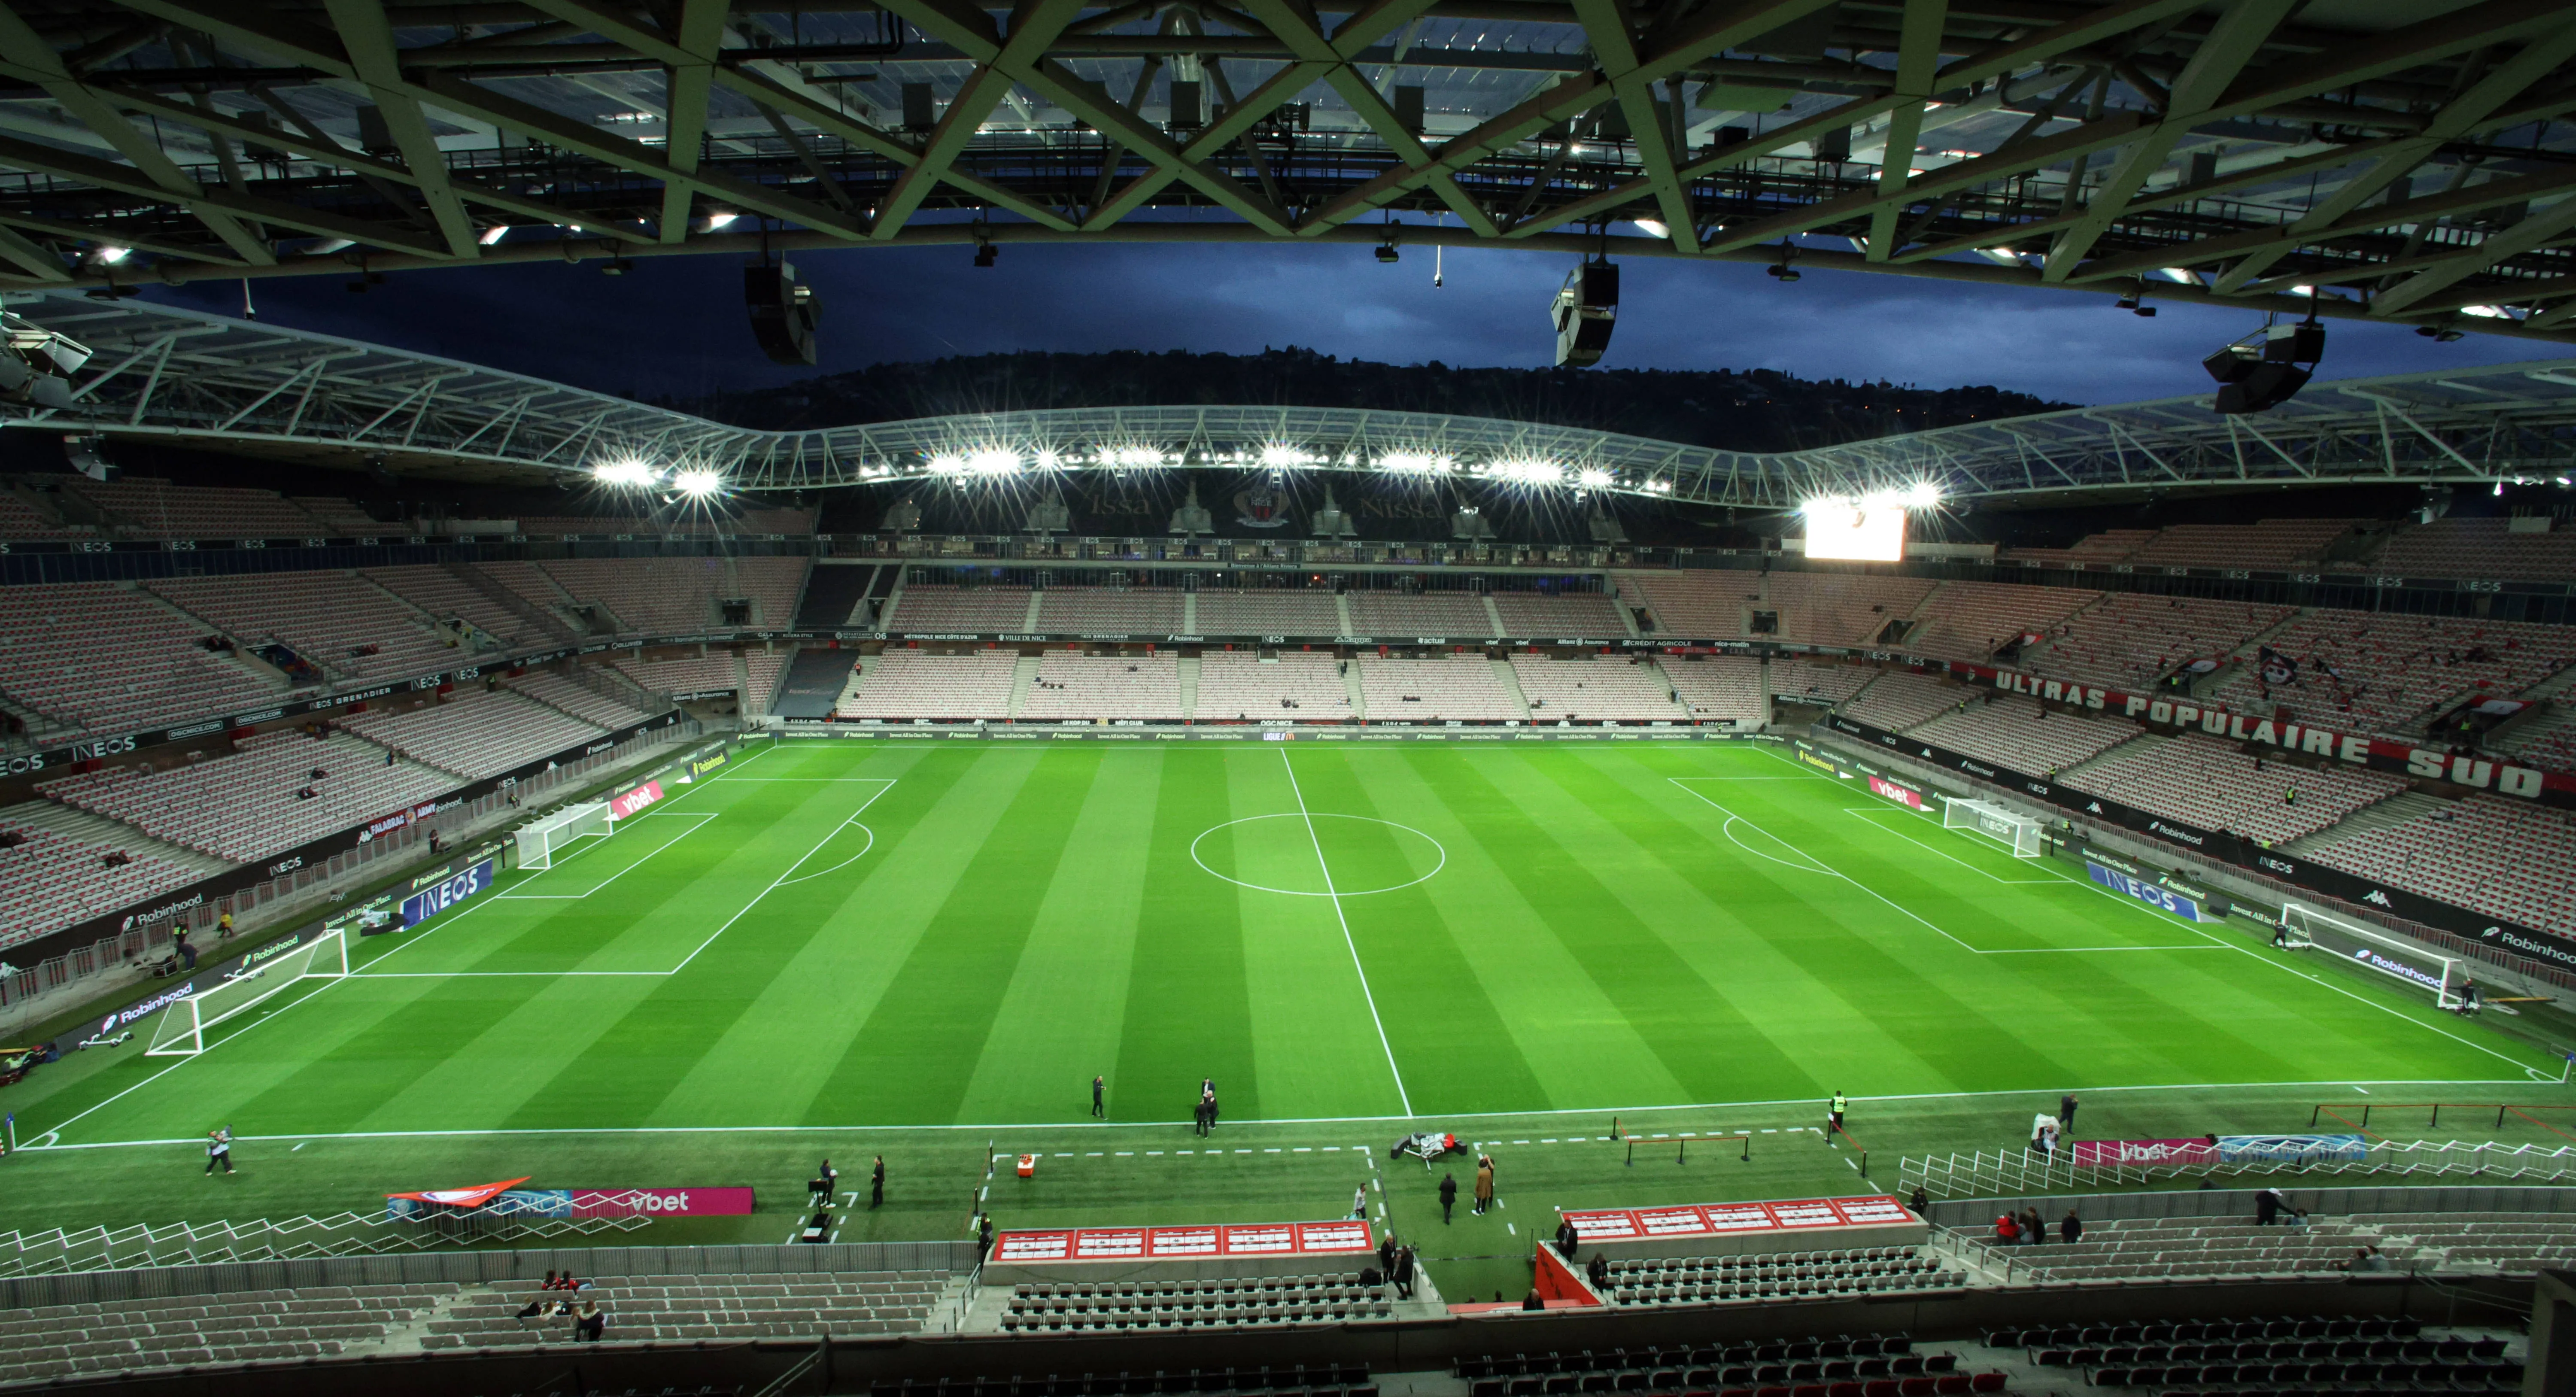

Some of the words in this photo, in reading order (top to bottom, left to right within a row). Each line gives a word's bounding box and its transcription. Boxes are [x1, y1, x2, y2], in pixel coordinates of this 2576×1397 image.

[70, 543, 112, 552] INEOS
[161, 541, 195, 550] INEOS
[2365, 577, 2403, 586] INEOS
[2457, 581, 2502, 592] INEOS
[1864, 651, 1890, 661] INEOS
[1901, 655, 1925, 667] INEOS
[411, 675, 441, 690] INEOS
[452, 668, 479, 681] INEOS
[309, 698, 332, 710] INEOS
[336, 687, 392, 705] GRENADIER
[238, 710, 282, 725] OGCNICE.COM
[170, 722, 222, 738] OGCNICE.COM
[1263, 732, 1281, 741] LIGUE
[1996, 671, 2105, 710] ULTRAS
[2125, 695, 2371, 764] POPULAIRE
[2406, 748, 2544, 799] SUD
[72, 735, 136, 762] INEOS
[591, 740, 613, 754] Robinhood
[0, 753, 44, 775] EOS
[699, 752, 726, 773] Robinhood
[1804, 753, 1835, 773] Robinhood
[496, 776, 516, 790] INEOS
[2027, 782, 2048, 795] INEOS
[622, 786, 654, 813] vbet
[1877, 782, 1910, 805] vbet
[371, 814, 405, 835] FALABRAC
[417, 802, 436, 818] ARMY
[1980, 817, 2010, 835] INEOS
[2037, 831, 2066, 846] Robinood
[2160, 824, 2203, 846] Robinhood
[269, 856, 303, 876] INEOS
[2082, 848, 2098, 859] Invest
[2112, 859, 2123, 869] One
[2123, 863, 2139, 875] Place
[2259, 856, 2293, 875] INEOS
[419, 866, 450, 886] Robinhood
[419, 869, 479, 920] INEOS
[2104, 869, 2177, 912] INEOS
[2167, 879, 2205, 900] Robinhood
[137, 893, 203, 926] Robinhood
[325, 915, 345, 929] Invest
[346, 909, 355, 920] All
[363, 902, 376, 910] One
[375, 894, 391, 906] Place
[2230, 903, 2252, 917] Invest
[2251, 911, 2264, 921] All
[2263, 915, 2272, 924] in
[2288, 924, 2309, 938] Place
[253, 935, 298, 962] Robinhood
[120, 983, 193, 1023] Robinhood
[630, 1191, 689, 1212] vbet
